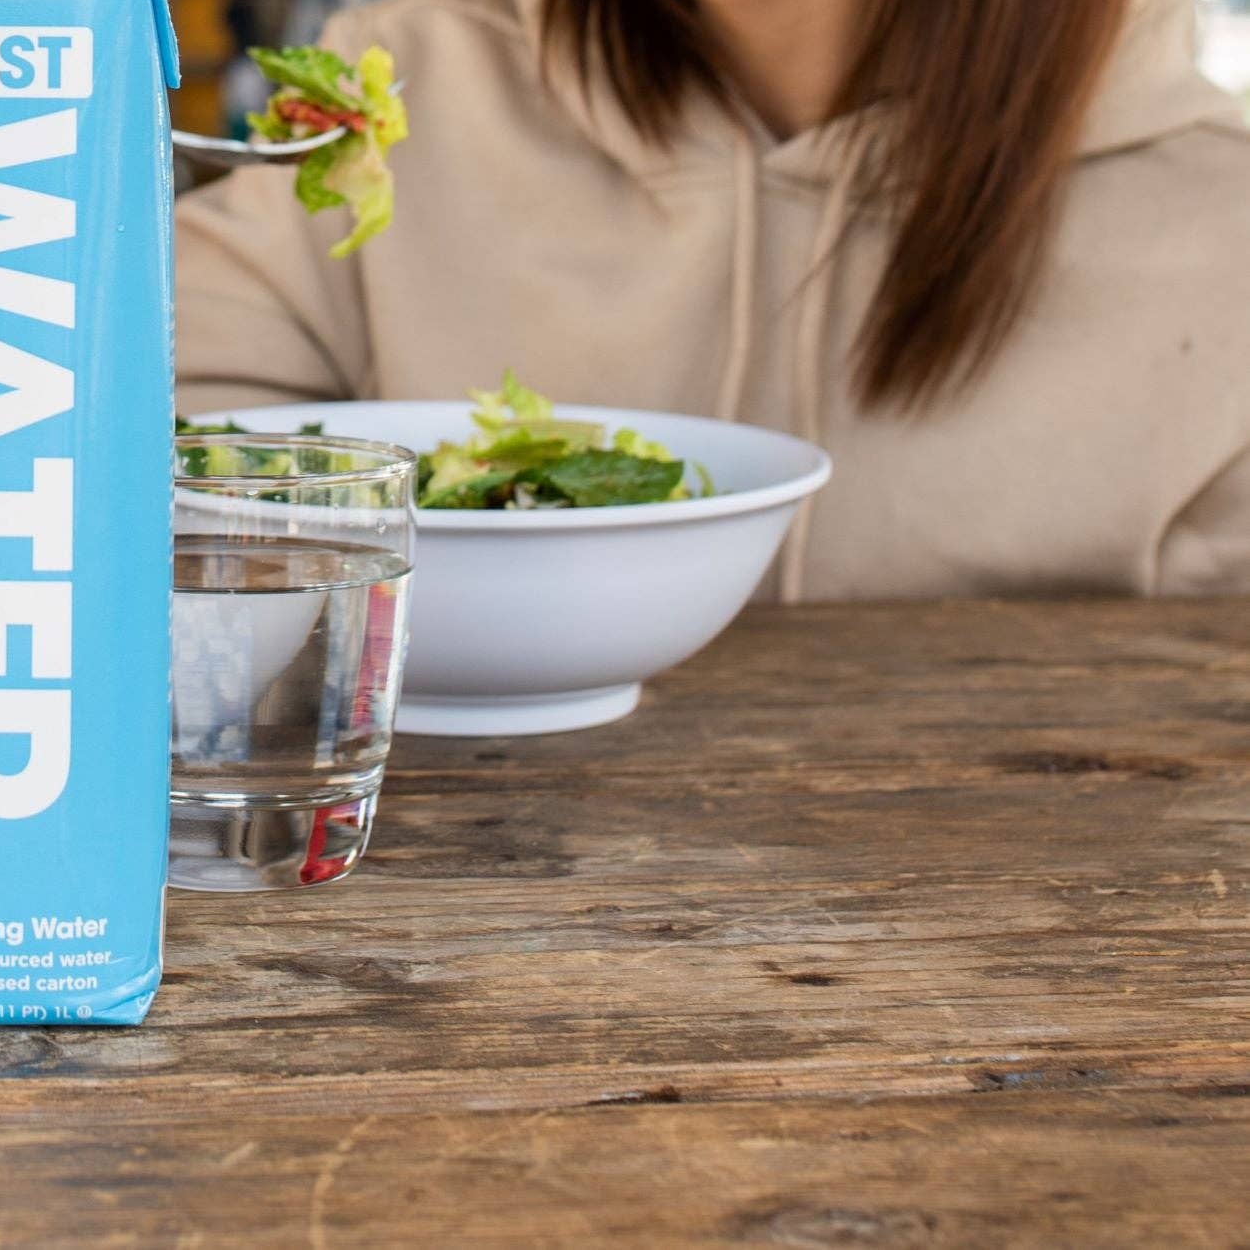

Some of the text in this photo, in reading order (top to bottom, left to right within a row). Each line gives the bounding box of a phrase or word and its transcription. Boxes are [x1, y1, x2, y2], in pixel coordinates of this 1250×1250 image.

[31, 916, 108, 939] Water
[60, 950, 111, 966] water
[36, 976, 97, 991] carton
[22, 1006, 47, 1020] PT)
[55, 1006, 71, 1018] 1L
